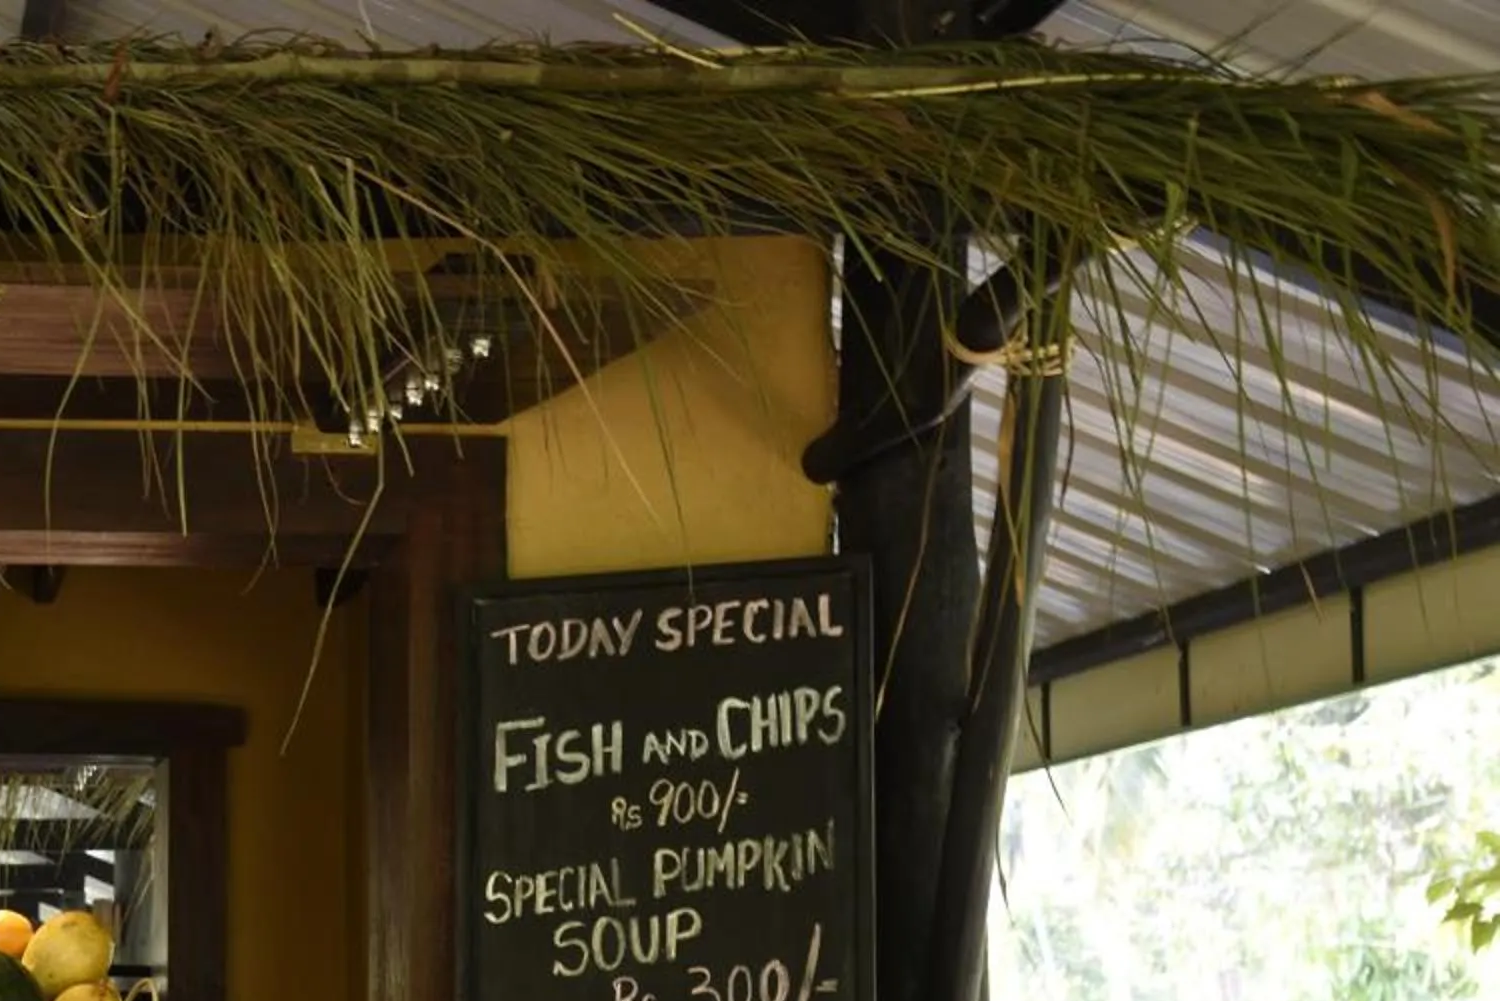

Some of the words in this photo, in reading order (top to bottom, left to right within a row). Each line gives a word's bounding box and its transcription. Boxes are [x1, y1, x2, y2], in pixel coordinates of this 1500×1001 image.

[491, 609, 643, 666] TODAY
[654, 593, 844, 652] SPECIAL
[715, 684, 847, 761] CHIPS
[483, 857, 637, 925] SPECIAL
[652, 816, 836, 899] PUMPKIN
[552, 907, 703, 977] SOUP
